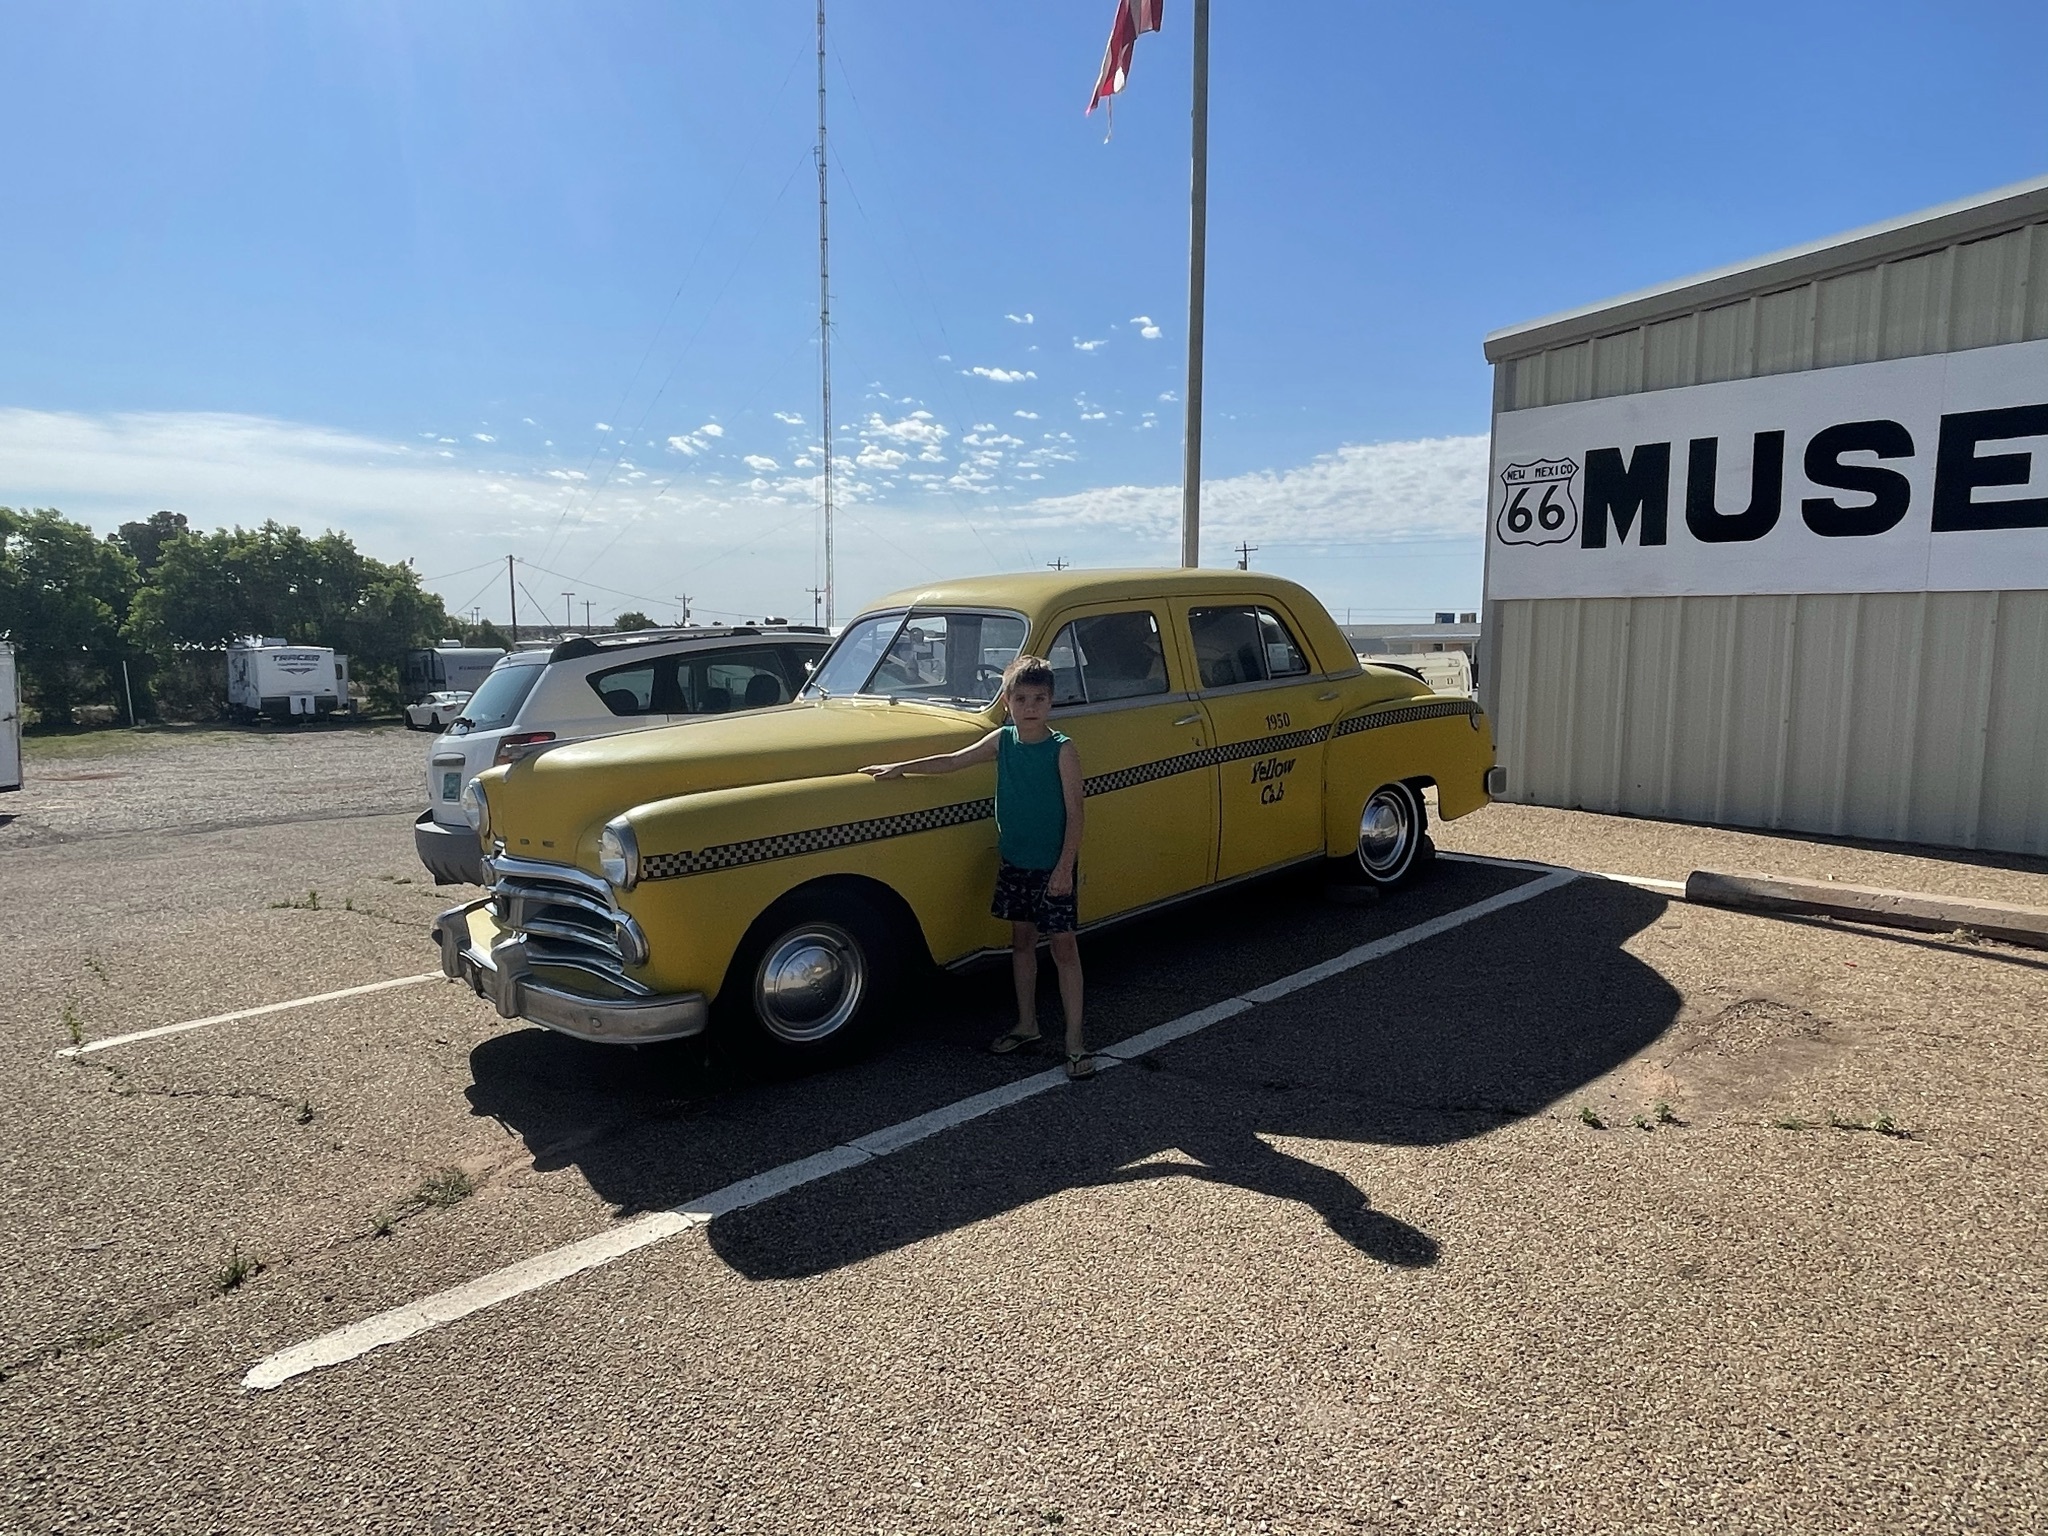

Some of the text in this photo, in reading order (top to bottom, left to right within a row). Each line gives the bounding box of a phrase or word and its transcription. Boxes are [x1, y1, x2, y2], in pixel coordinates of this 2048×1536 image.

[1507, 464, 1573, 481] NEW MEXICO
[1581, 403, 2048, 549] MUSE
[1507, 484, 1566, 533] 66
[272, 654, 321, 662] TRACER
[1265, 712, 1291, 731] 1950
[1250, 758, 1297, 785] Yellow
[1261, 781, 1285, 805] Cab
